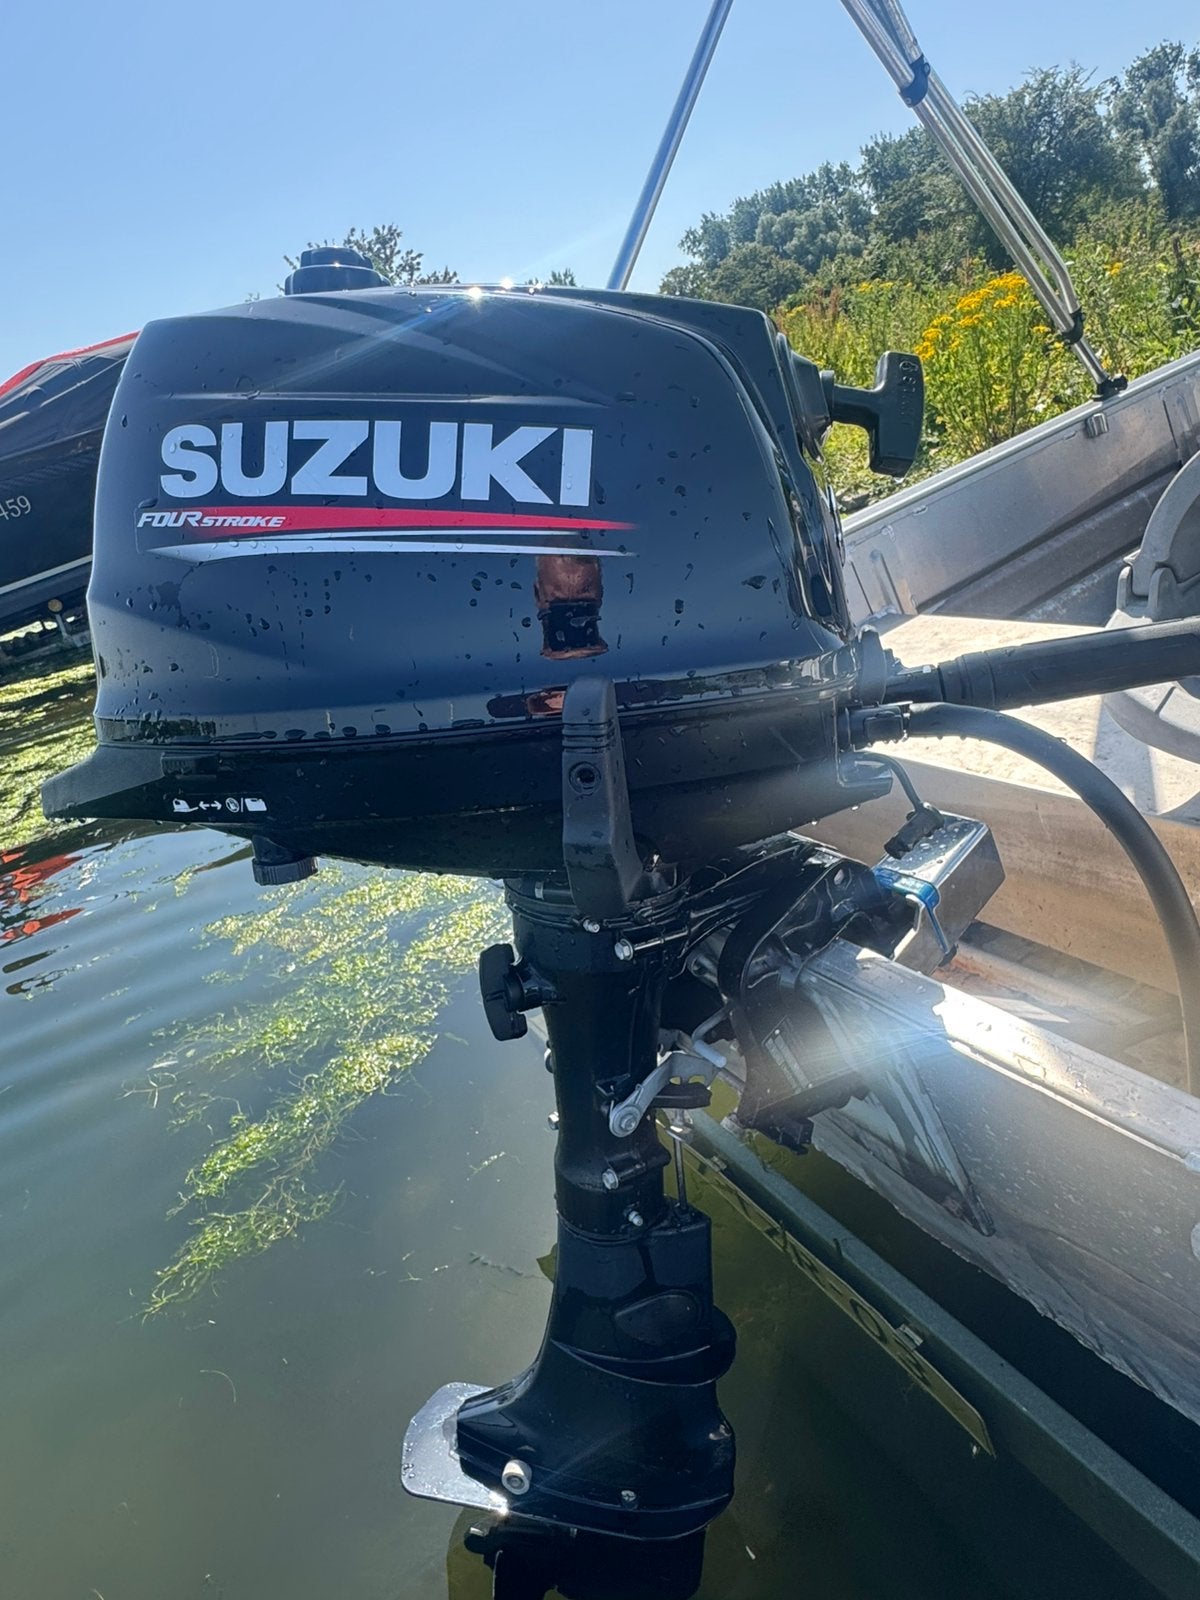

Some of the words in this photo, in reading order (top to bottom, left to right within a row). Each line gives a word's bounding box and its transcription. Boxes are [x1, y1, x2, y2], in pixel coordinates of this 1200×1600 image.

[160, 420, 594, 507] SUZUKI
[137, 511, 203, 528] FOUR
[200, 516, 287, 528] STROKE
